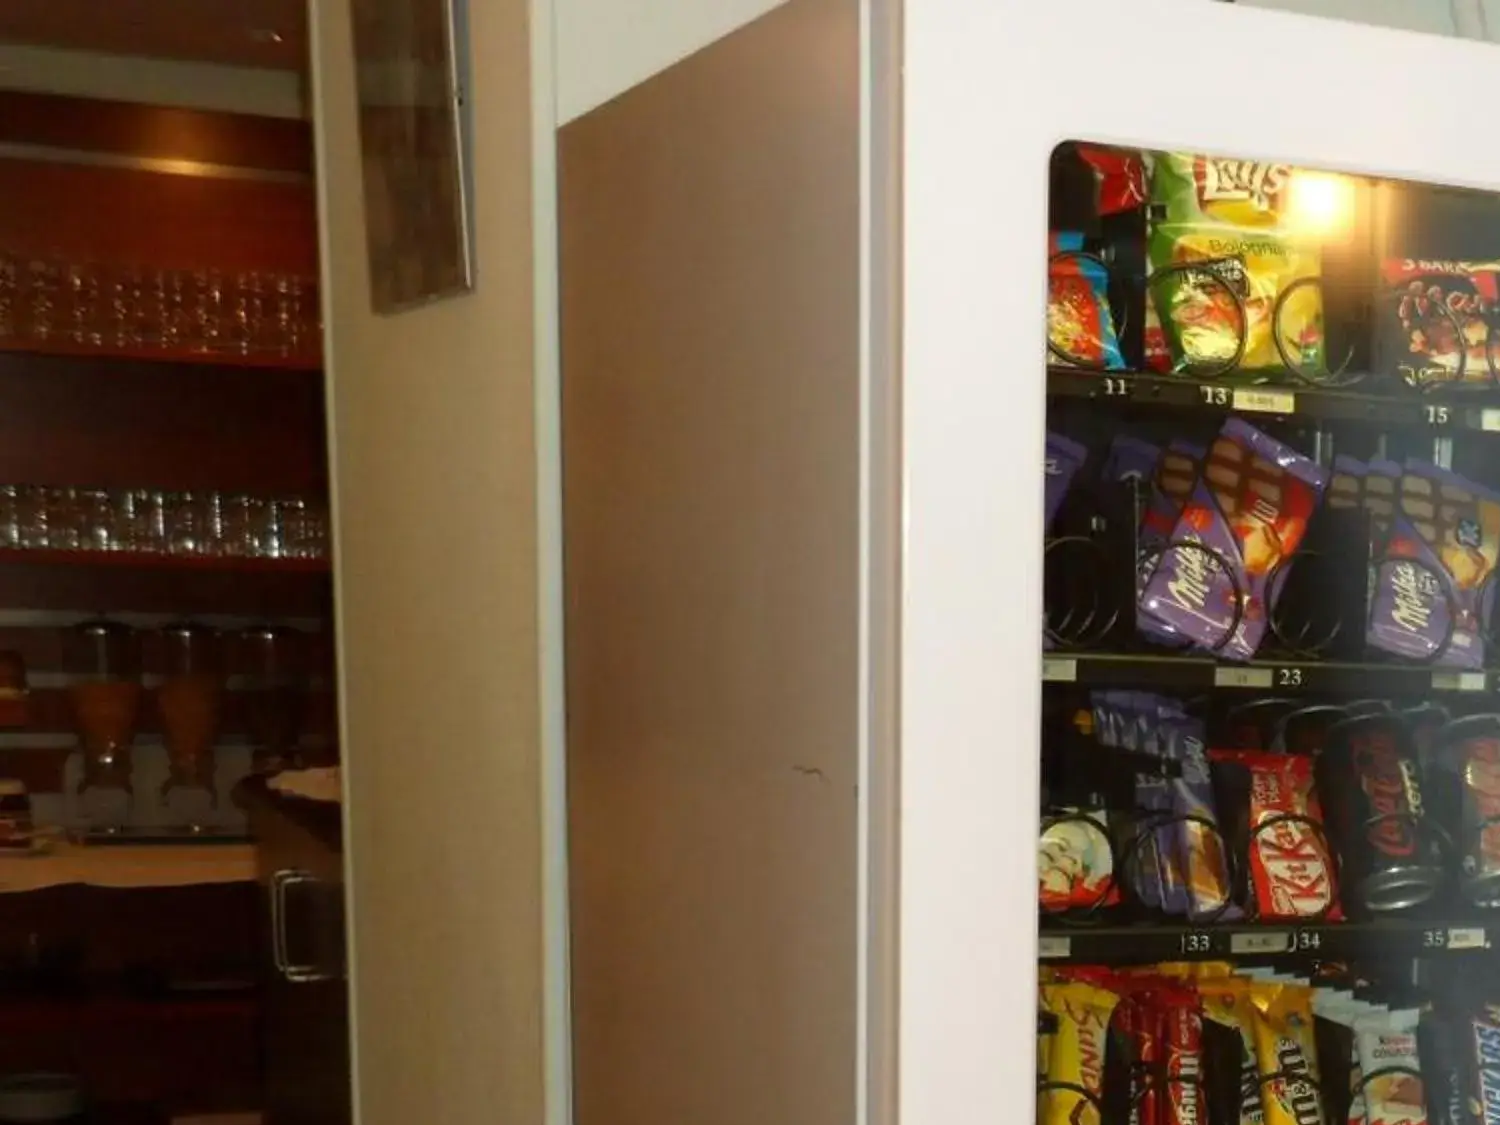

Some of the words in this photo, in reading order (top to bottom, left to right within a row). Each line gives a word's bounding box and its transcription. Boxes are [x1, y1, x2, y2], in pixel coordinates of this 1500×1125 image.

[1105, 379, 1127, 395] 11
[1205, 387, 1228, 404] 13
[1427, 406, 1448, 424] 15
[1280, 670, 1301, 686] 23
[1186, 934, 1210, 951] 33
[1300, 933, 1320, 949] 34
[1424, 930, 1445, 947] 35
